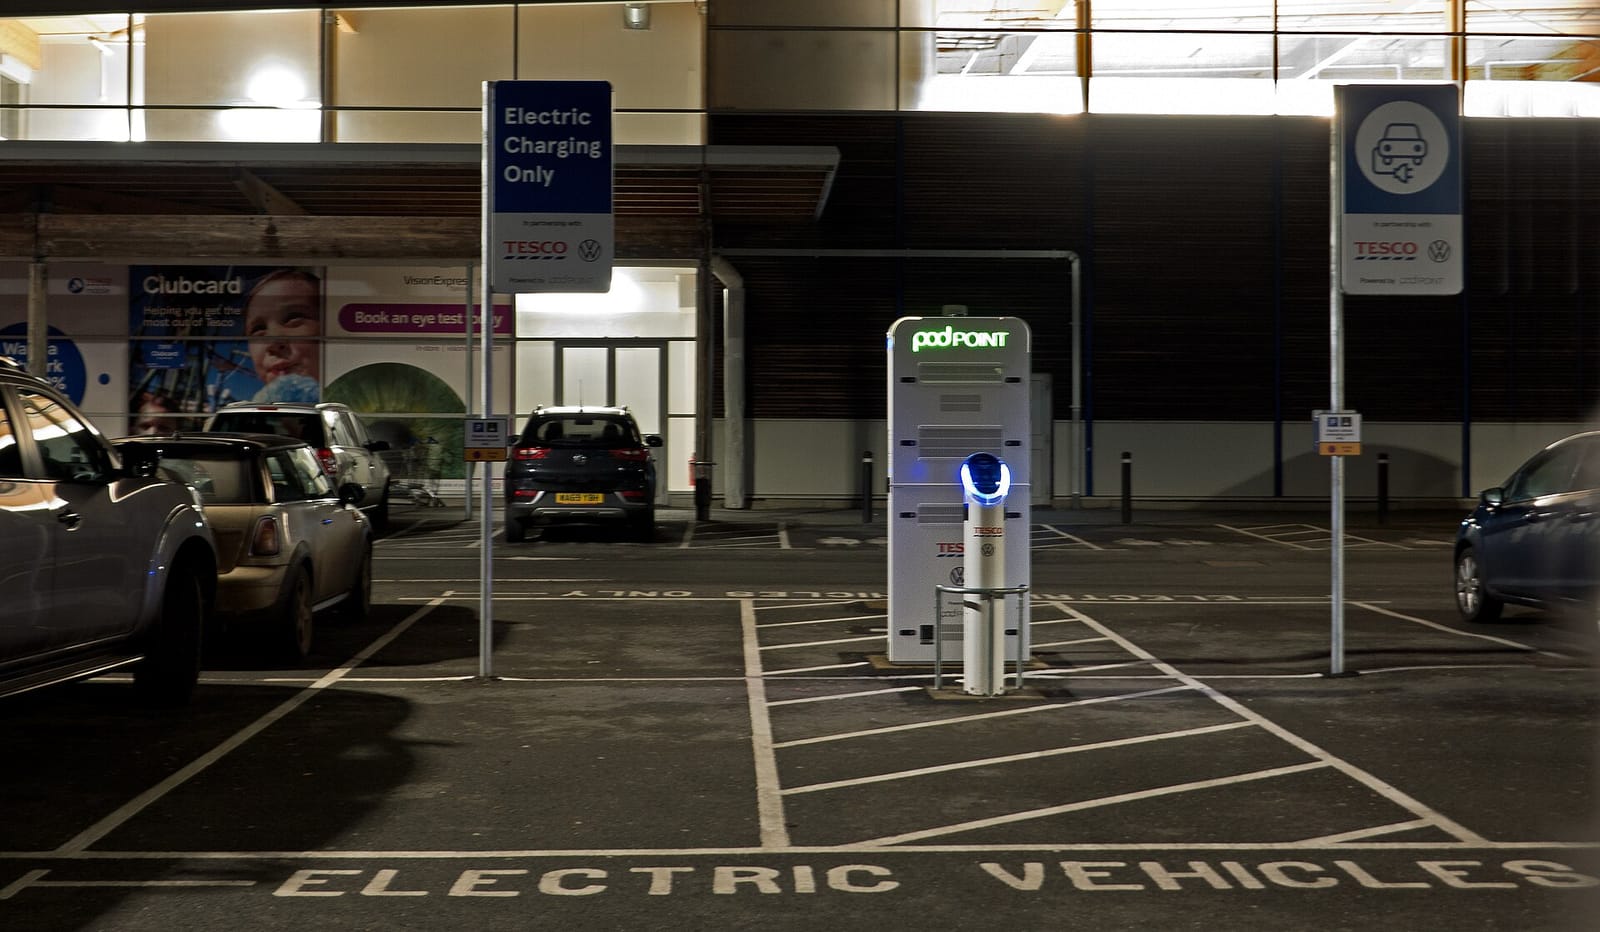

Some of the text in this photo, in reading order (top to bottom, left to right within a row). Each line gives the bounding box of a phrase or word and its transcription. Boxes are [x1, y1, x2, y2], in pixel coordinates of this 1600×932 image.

[504, 107, 592, 126] Electric
[504, 136, 602, 159] Charging
[504, 165, 555, 187] Only
[503, 241, 568, 254] TESCO
[1354, 242, 1418, 255] TESCO
[143, 274, 241, 294] Clubcard
[403, 275, 468, 287] VisionExpres
[143, 306, 241, 318] Helping you get the
[143, 318, 170, 328] most
[172, 318, 190, 328] out
[206, 318, 234, 328] Tesco
[354, 311, 390, 324] Book
[391, 314, 409, 324] an
[411, 314, 434, 328] eye
[438, 312, 465, 325] test
[936, 542, 964, 553] TES
[560, 590, 693, 598] ONLY
[271, 860, 1599, 897] ELECTRIC VEHICLES
